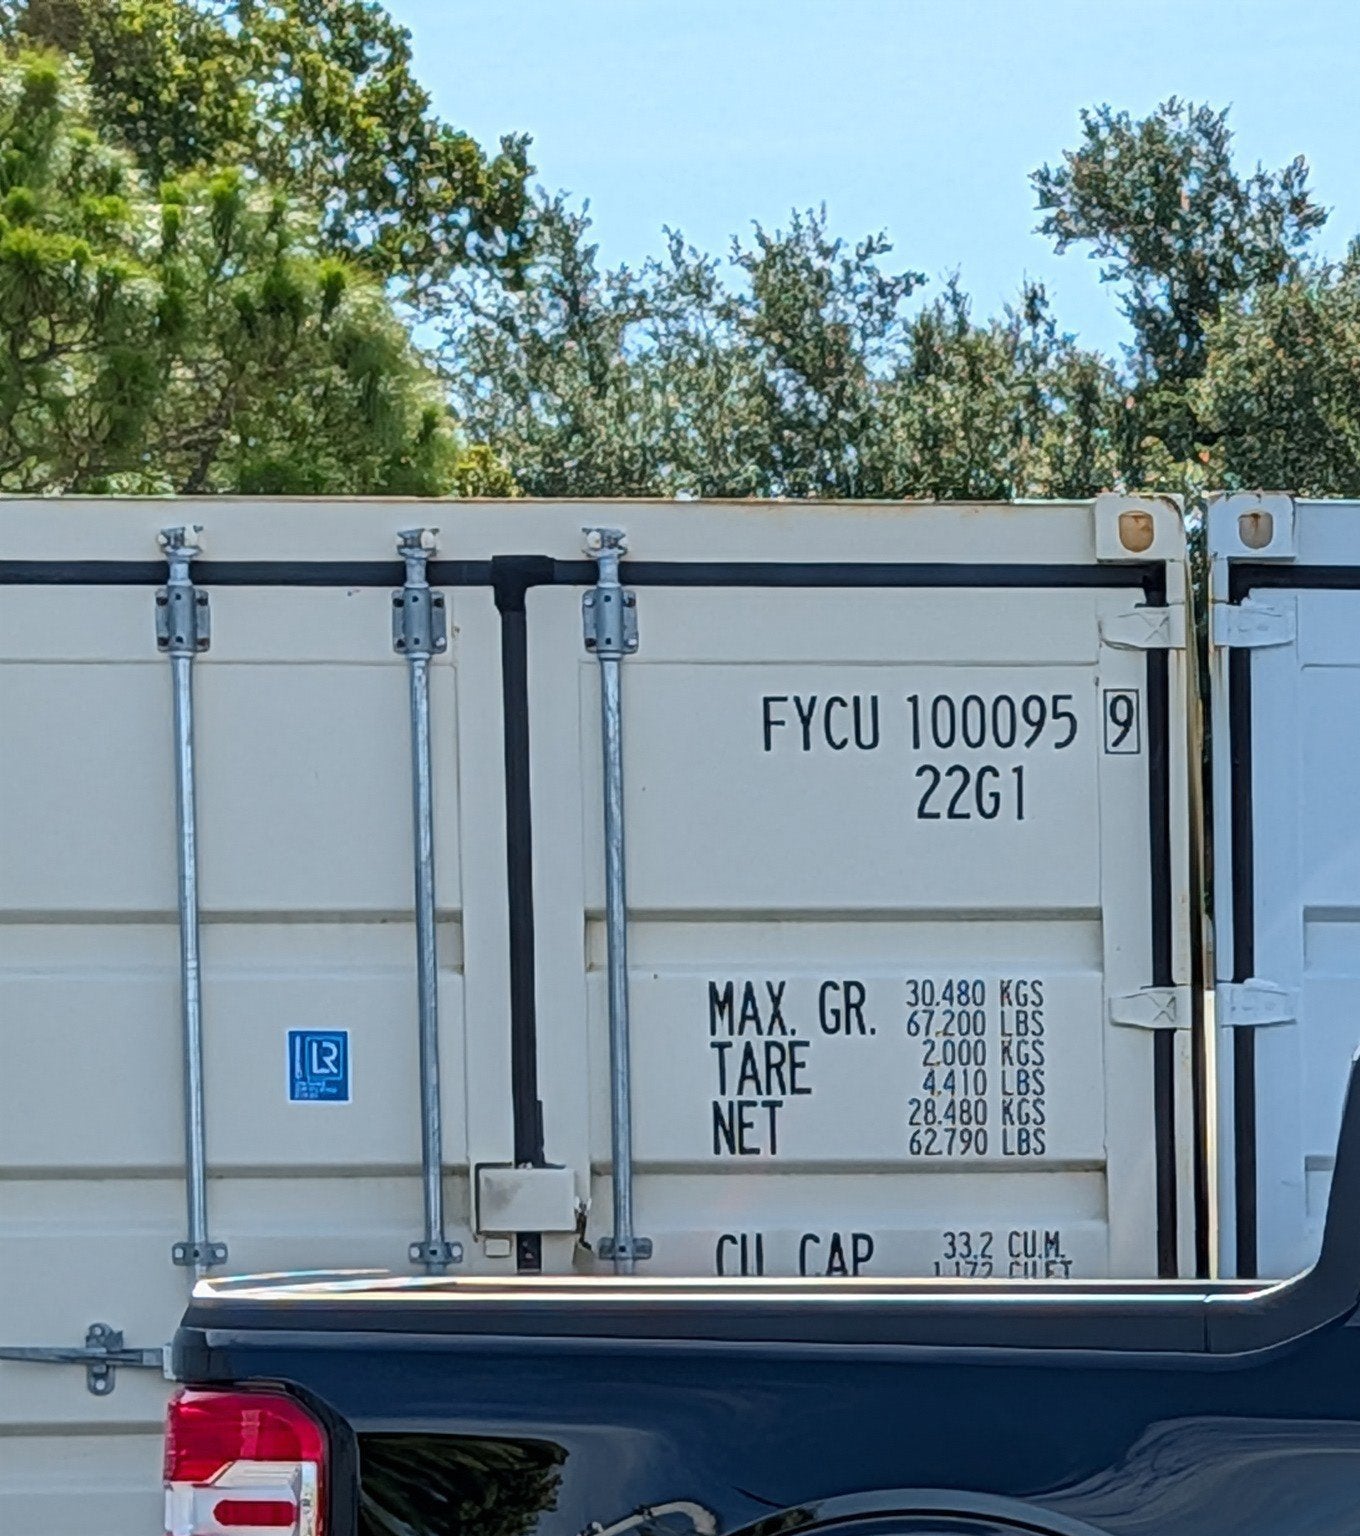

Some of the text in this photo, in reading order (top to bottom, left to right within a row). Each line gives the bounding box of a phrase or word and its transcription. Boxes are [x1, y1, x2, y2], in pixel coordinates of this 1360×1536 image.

[762, 694, 1135, 752] FYCU 100095 9
[915, 764, 1025, 820] 22G1
[906, 979, 1044, 1007] 30.480 KGS
[709, 980, 877, 1036] MAX. GR.
[907, 1009, 1044, 1037] 67.200 LBS
[312, 1041, 338, 1073] LR
[923, 1039, 1045, 1067] 2.000 KGS
[710, 1041, 812, 1096] TARE
[923, 1069, 1045, 1097] 4.410 LBS
[908, 1098, 1045, 1126] 28.480 KGS
[712, 1100, 784, 1155] NET
[1002, 1127, 1046, 1156] LBS
[943, 1231, 993, 1259] 33.2
